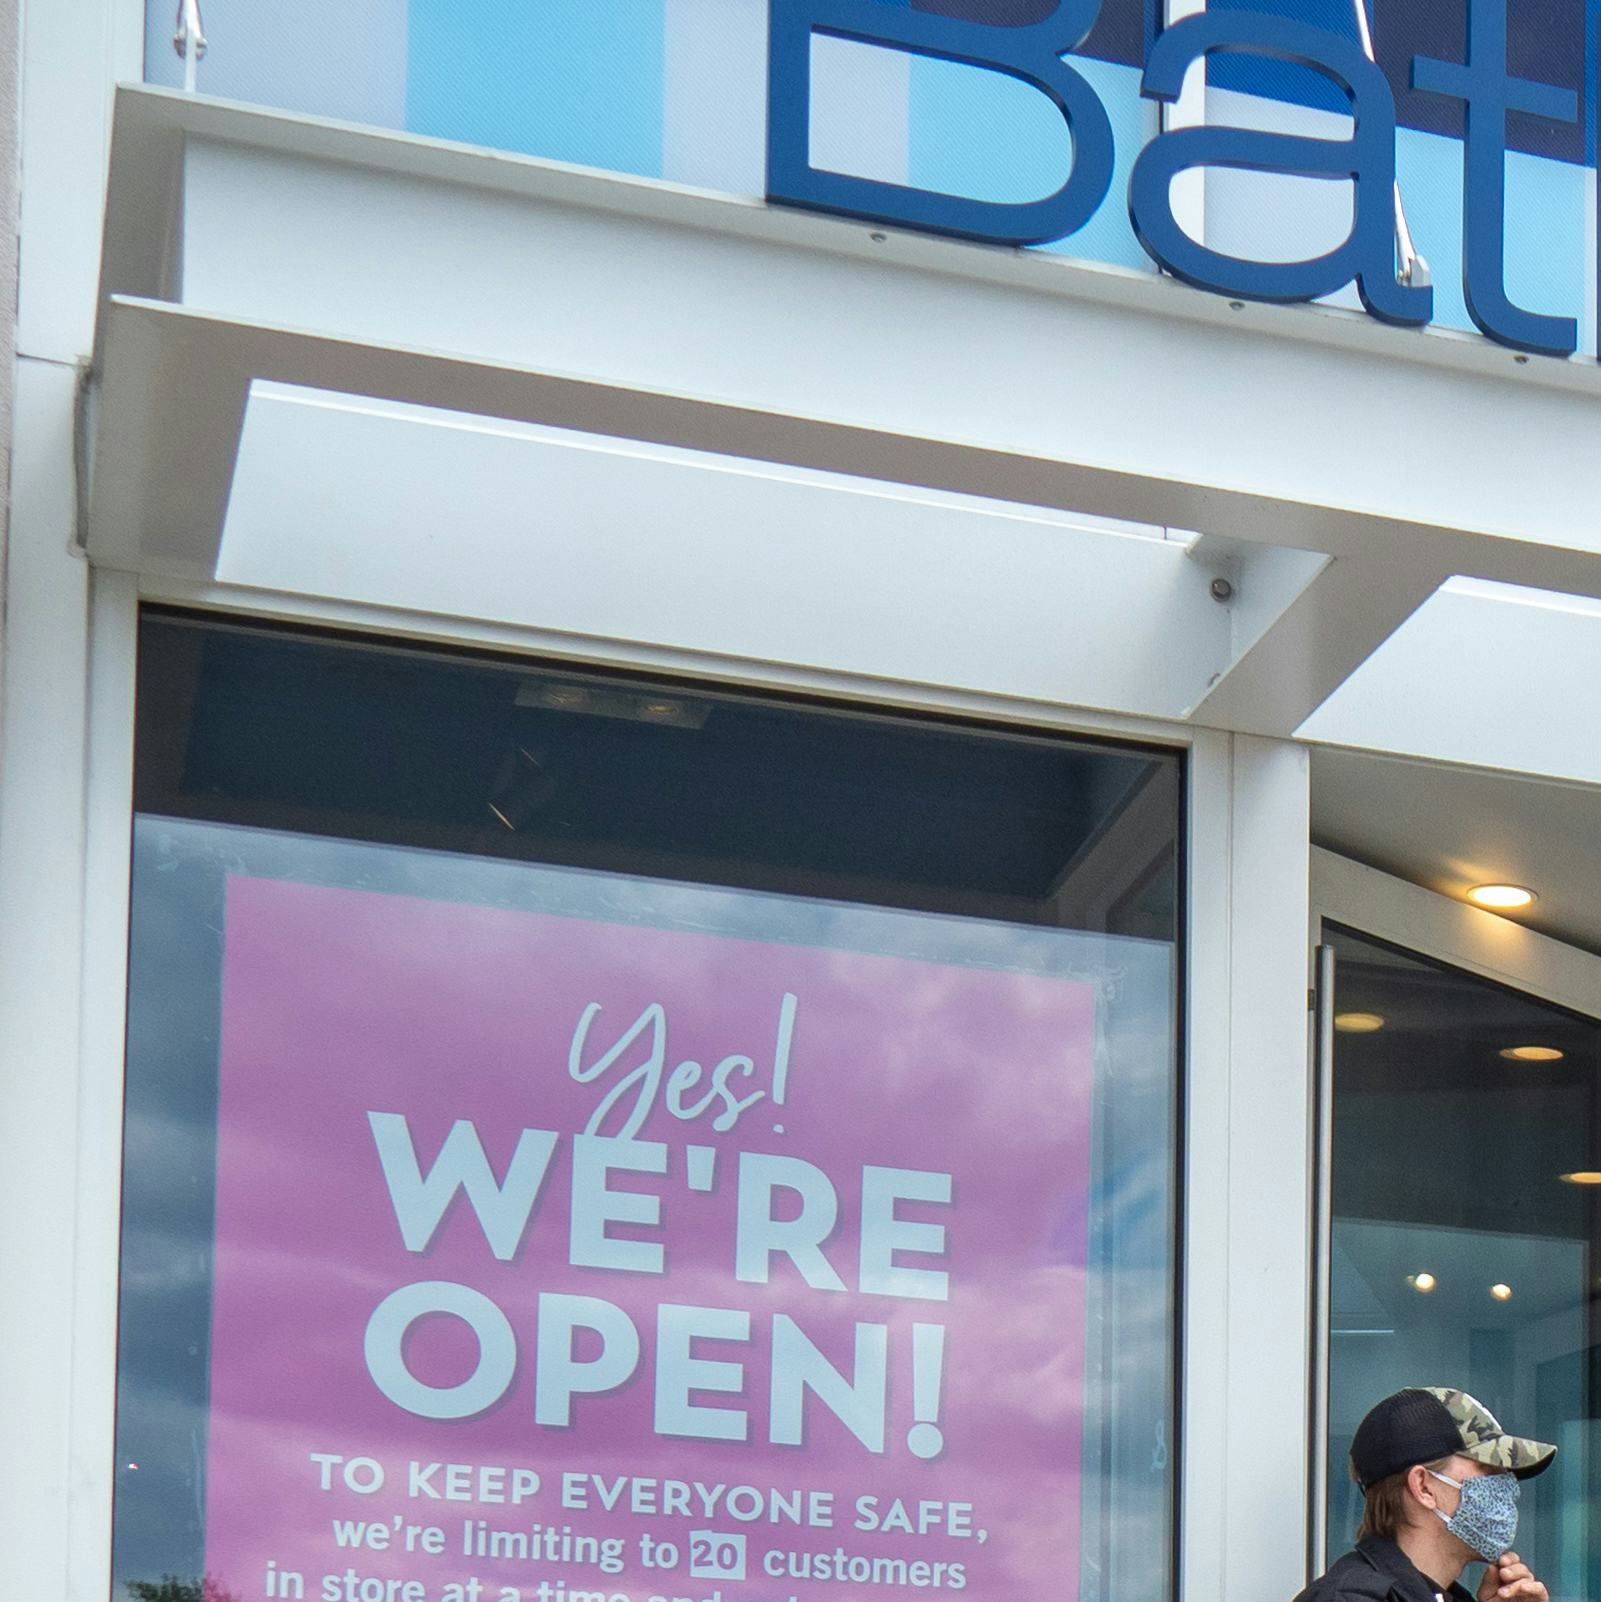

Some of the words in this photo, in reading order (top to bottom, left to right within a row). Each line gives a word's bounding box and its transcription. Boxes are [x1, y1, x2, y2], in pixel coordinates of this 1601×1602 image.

[568, 992, 798, 1141] Yes!
[366, 1111, 952, 1302] WE'RE
[363, 1280, 945, 1459] OPEN!
[310, 1453, 384, 1493] TO
[409, 1462, 540, 1504] KEEP
[562, 1472, 833, 1526] EVERYONE
[854, 1496, 987, 1543] SAFE,
[333, 1516, 445, 1553] we're
[464, 1520, 624, 1572] limiting
[640, 1534, 678, 1568] to
[691, 1537, 738, 1572] 20
[764, 1548, 966, 1588] customers
[267, 1561, 303, 1599] in
